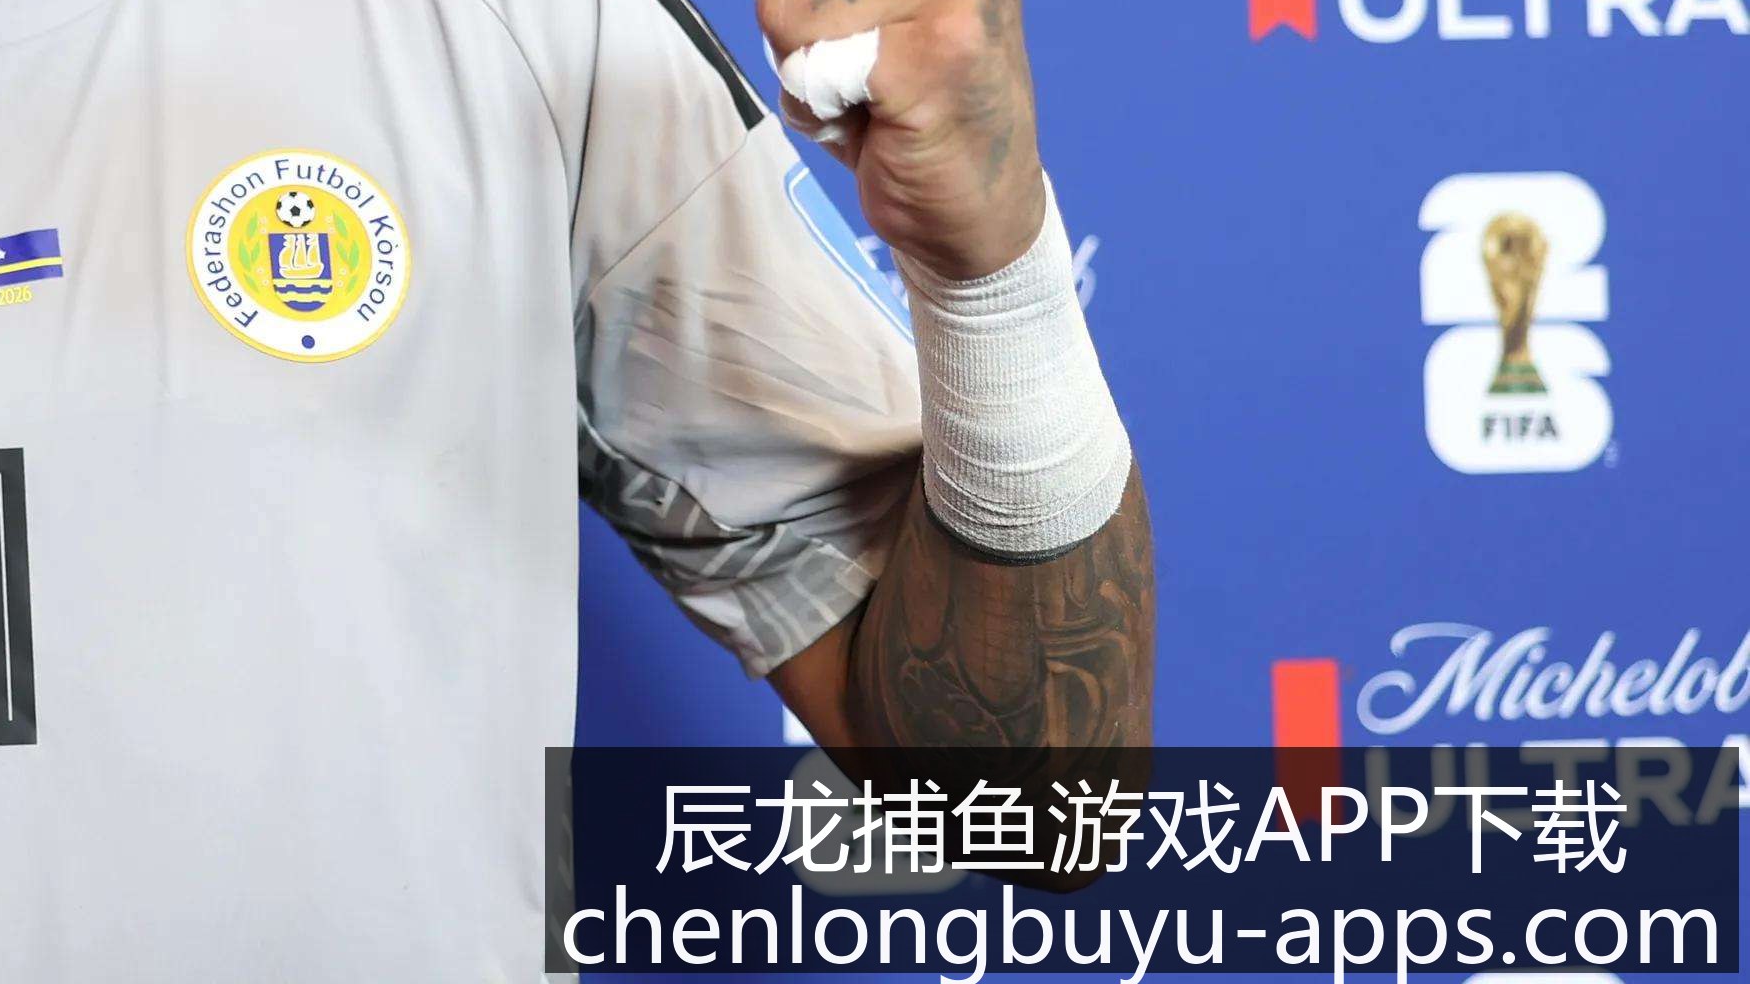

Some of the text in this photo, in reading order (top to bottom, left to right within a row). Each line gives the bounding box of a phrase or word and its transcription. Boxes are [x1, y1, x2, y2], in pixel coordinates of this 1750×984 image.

[205, 171, 266, 329] Federashon
[1481, 415, 1560, 441] FIFA
[1356, 621, 1750, 736] Michelob
